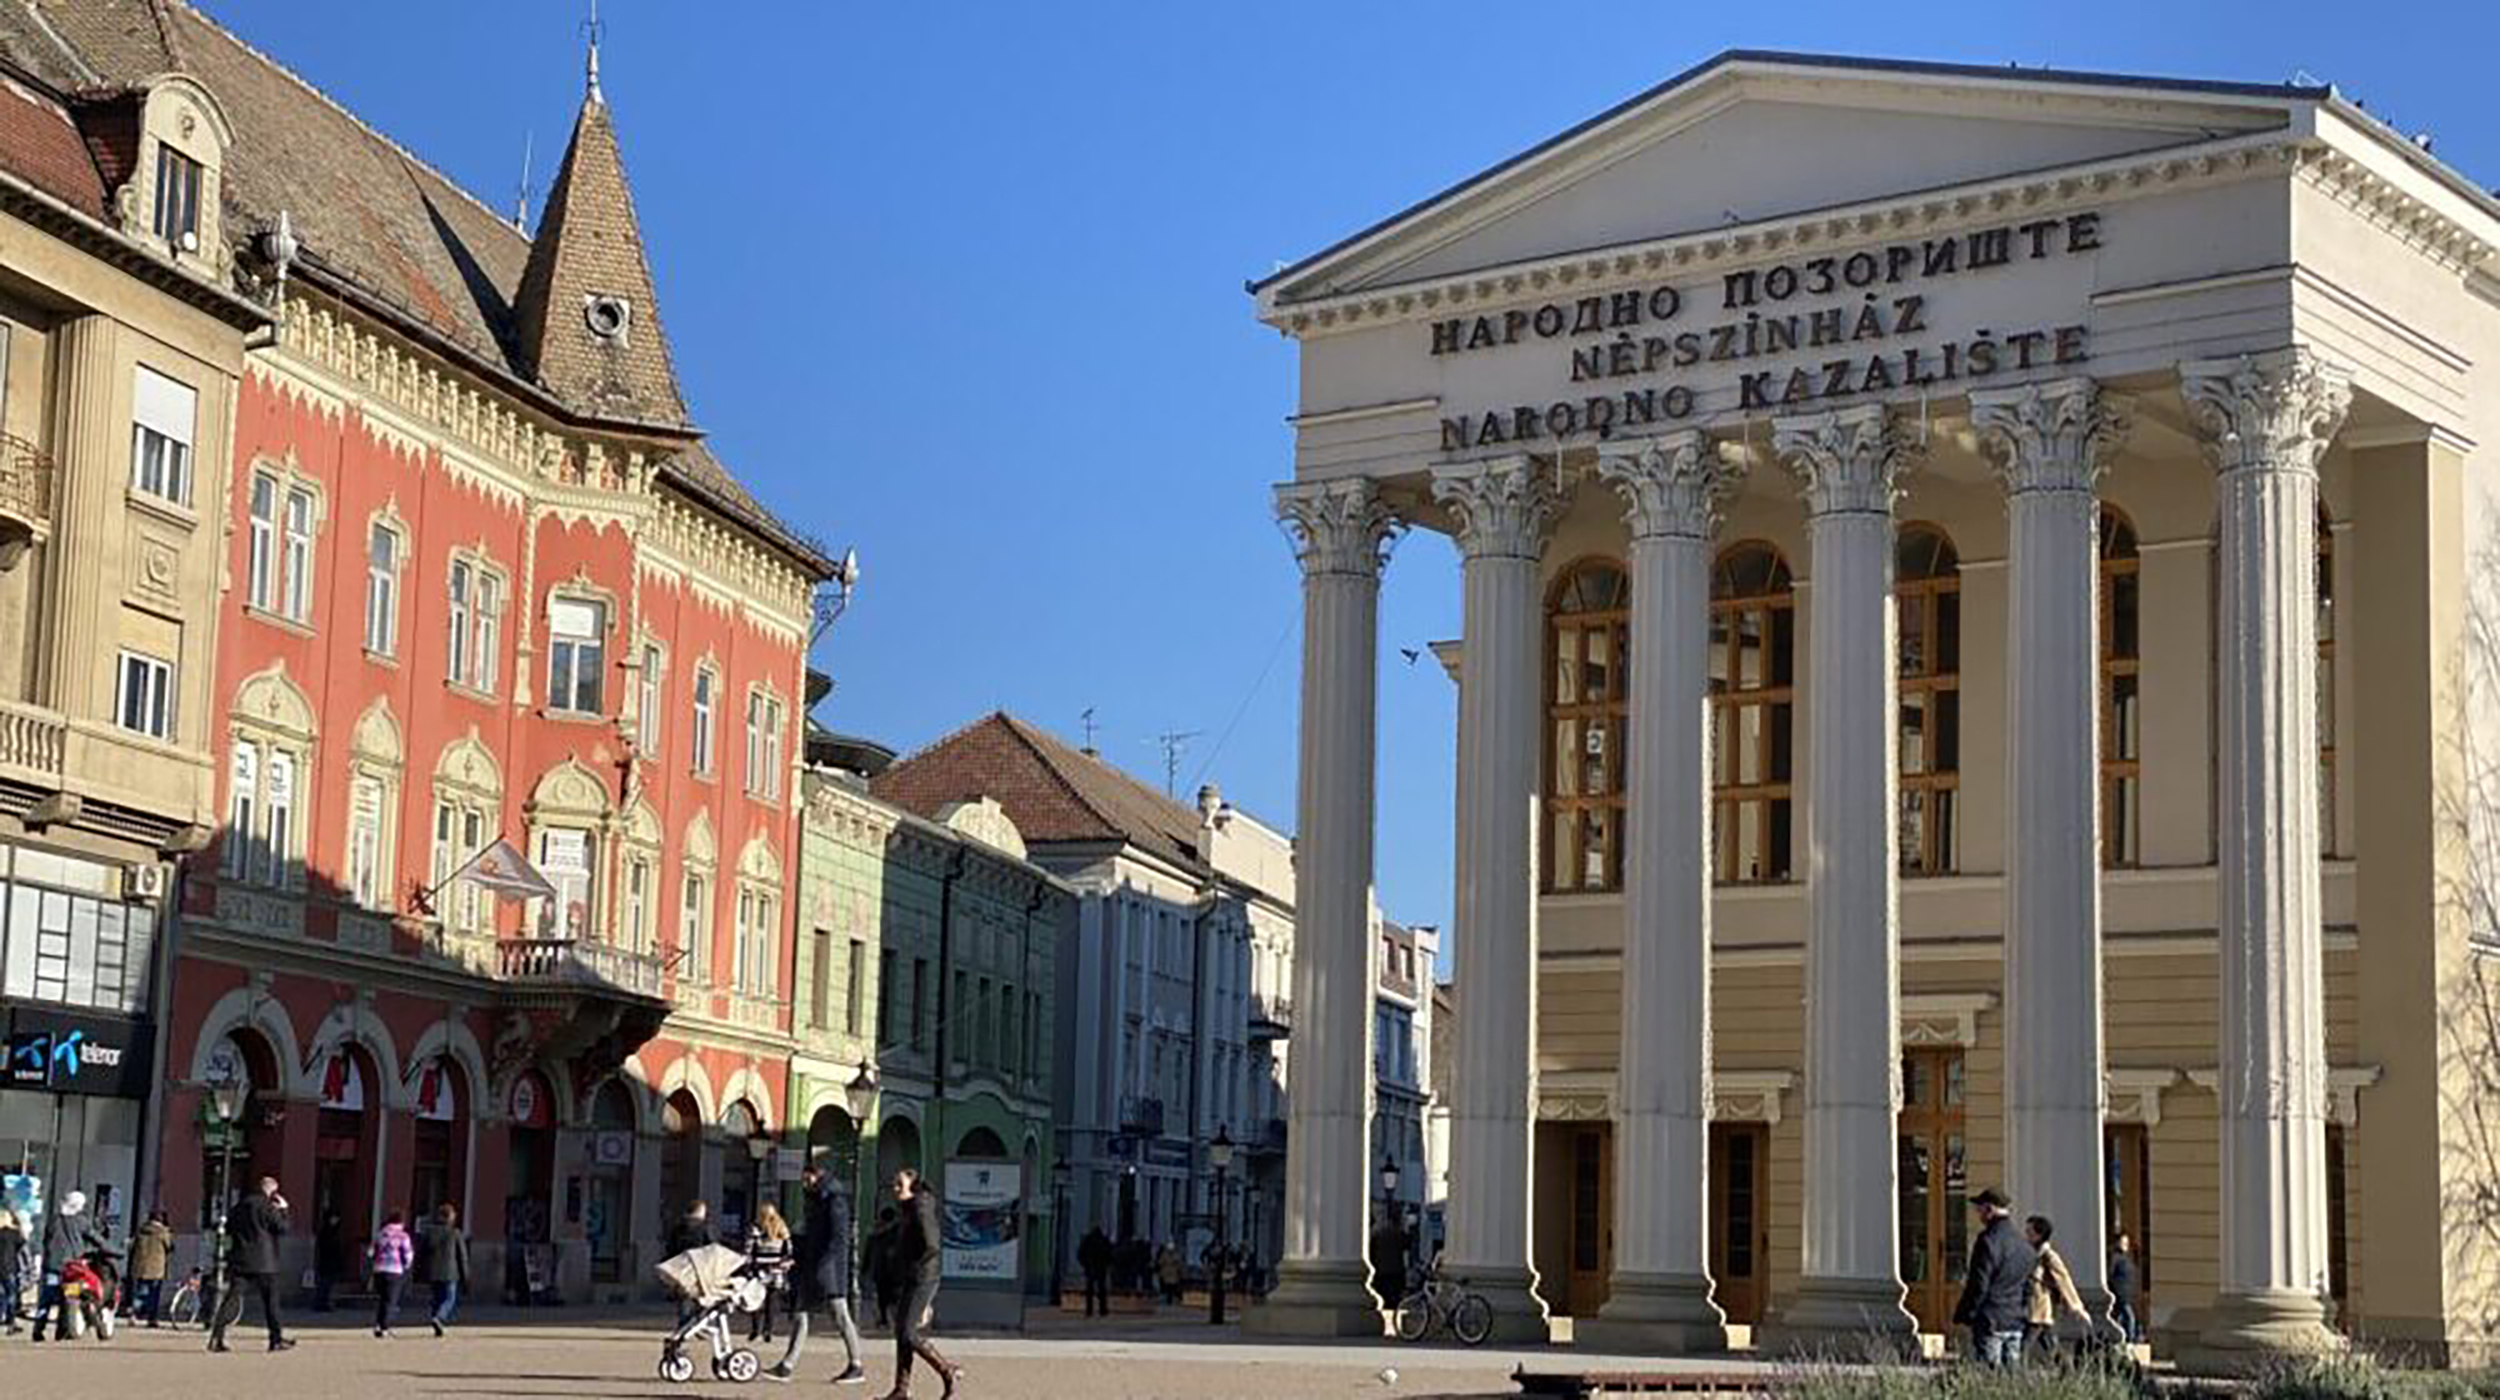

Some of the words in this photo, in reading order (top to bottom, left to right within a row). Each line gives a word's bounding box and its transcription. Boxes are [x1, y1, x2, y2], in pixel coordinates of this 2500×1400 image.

[1431, 285, 1681, 356] НАРОДНО
[1724, 212, 2103, 308] ПОЗОРИШТЕ
[1441, 384, 1695, 451] NARODNO
[1739, 324, 2090, 411] KAZALIŠTE
[81, 1042, 121, 1065] telenor
